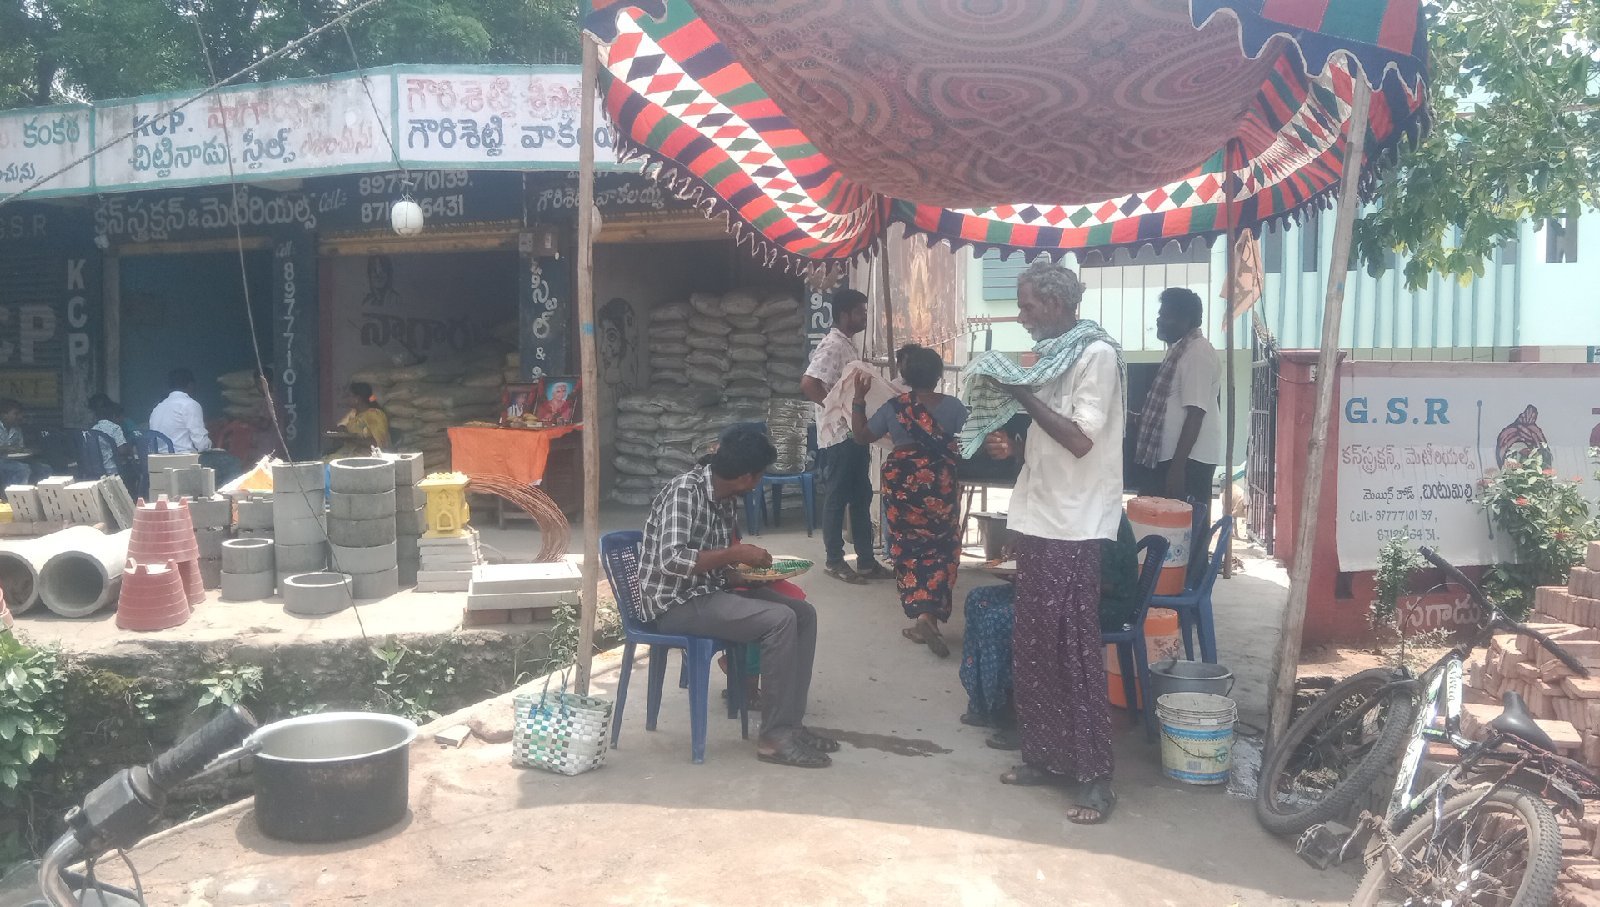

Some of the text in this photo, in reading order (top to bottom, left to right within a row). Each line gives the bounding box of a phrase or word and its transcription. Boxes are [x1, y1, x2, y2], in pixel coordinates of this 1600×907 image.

[407, 115, 504, 156] గౌరిశెట్టి
[361, 194, 465, 223] 8716431
[1345, 397, 1450, 425] G.S.R
